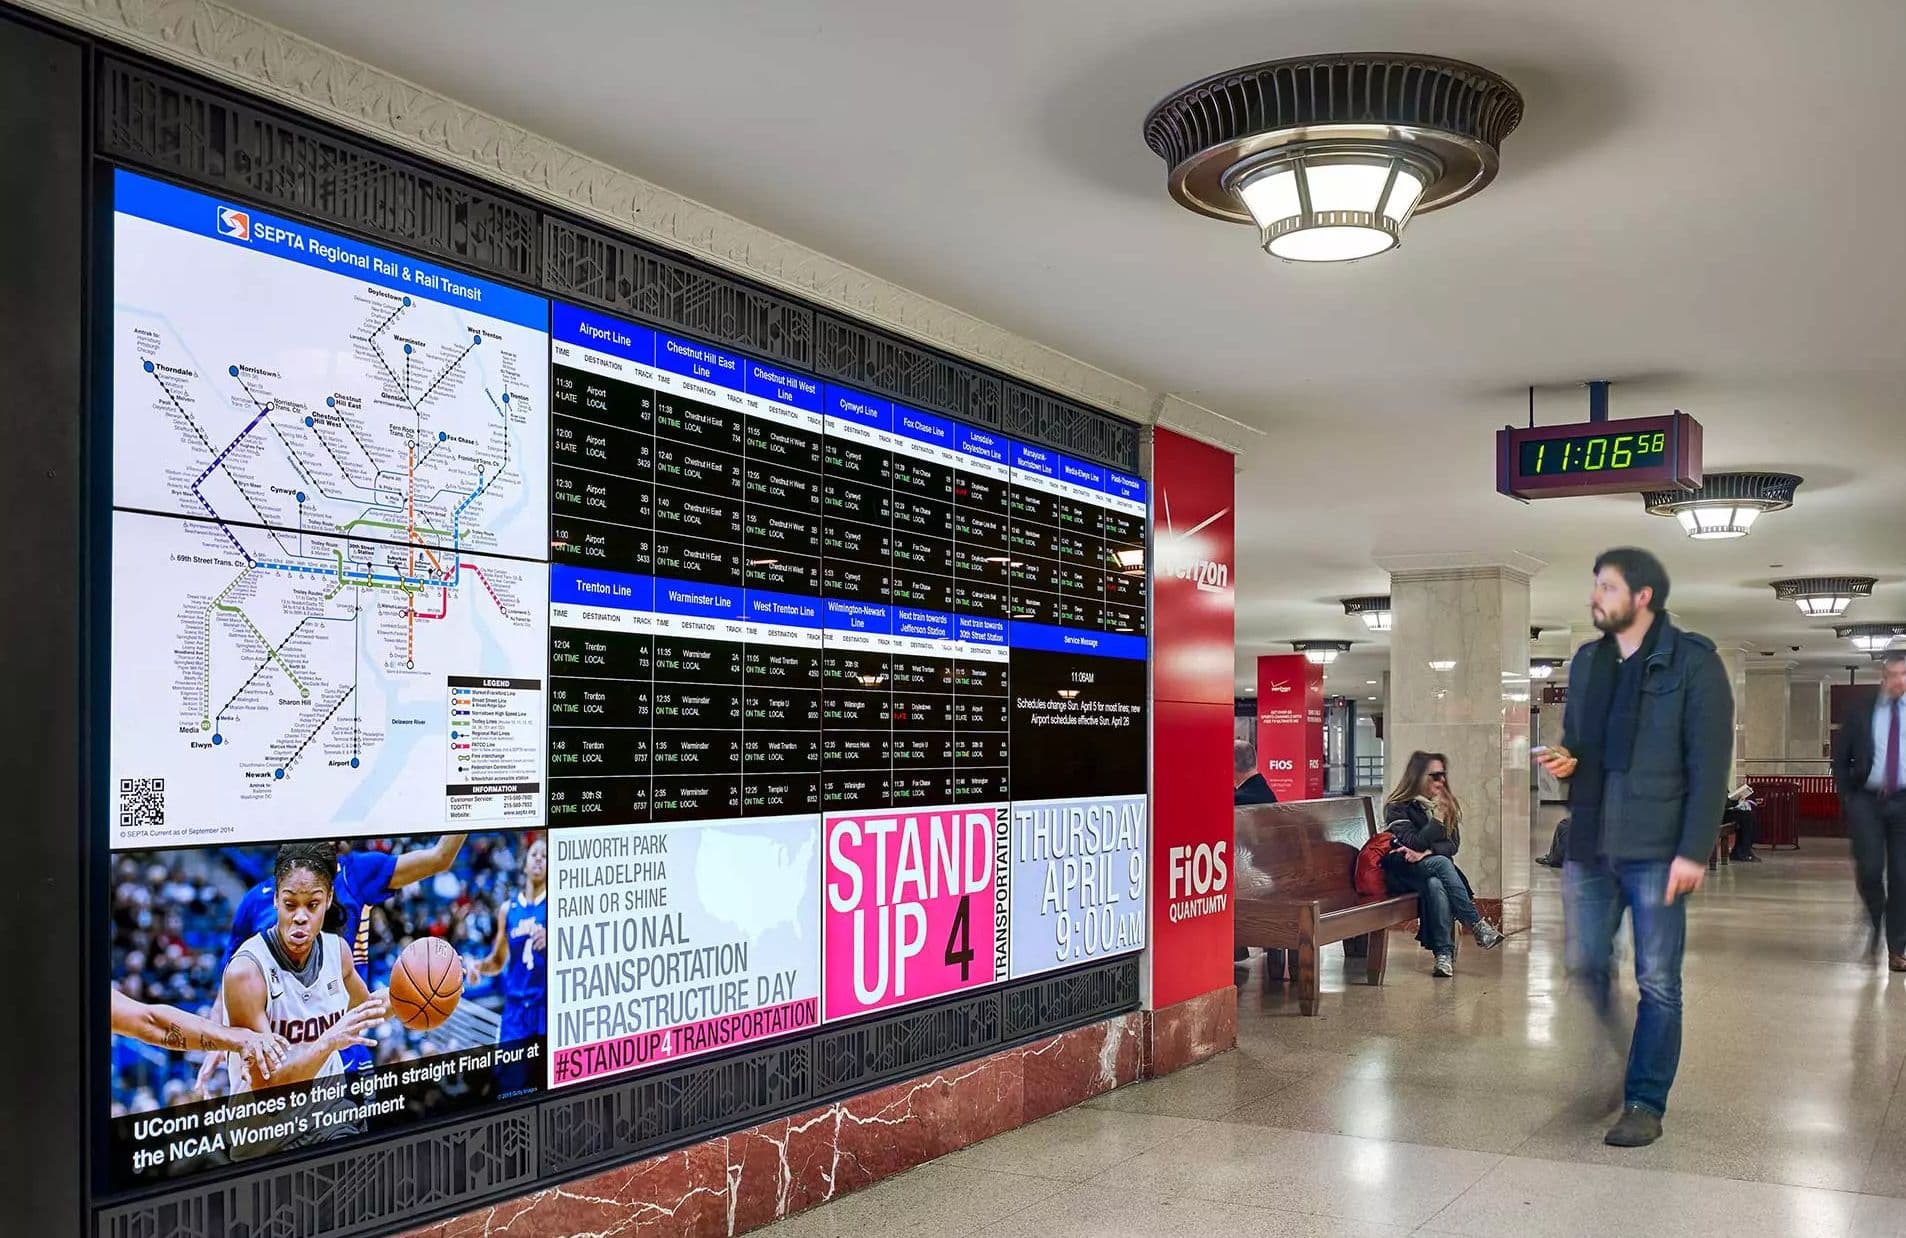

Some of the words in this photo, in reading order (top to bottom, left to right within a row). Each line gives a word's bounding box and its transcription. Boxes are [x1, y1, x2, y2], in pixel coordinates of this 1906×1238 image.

[254, 222, 304, 251] SEPTA
[309, 239, 369, 270] Regional
[373, 257, 398, 279] Rail
[401, 267, 412, 282] &
[415, 270, 439, 290] Rail
[440, 277, 482, 302] Transit
[367, 287, 401, 302] Doylestown
[394, 334, 426, 348] Warminster
[467, 326, 481, 336] West
[481, 329, 503, 341] Trenton
[579, 321, 611, 342] Airport
[612, 331, 632, 347] Line
[555, 346, 570, 357] TIME
[584, 354, 623, 372] DESTINATION
[635, 368, 653, 379] TRACK
[666, 340, 703, 361] Chestnut
[704, 351, 717, 365] Hill
[718, 356, 736, 371] East
[156, 363, 193, 377] Thorndale
[239, 364, 277, 378] Norristown
[693, 363, 711, 378] Line
[556, 378, 573, 389] 11:30
[586, 386, 607, 398] Airport
[753, 367, 786, 386] Chestnut
[786, 377, 798, 389] Hill
[798, 381, 816, 395] West
[334, 393, 361, 404] Chestnut
[561, 393, 578, 403] LATE
[586, 398, 608, 411] LOCAL
[777, 388, 793, 402] Line
[348, 401, 361, 409] East
[839, 398, 864, 415] Cynwyd
[864, 405, 878, 418] Line
[312, 411, 340, 422] Chestnut
[314, 418, 324, 426] Hill
[326, 420, 342, 428] West
[903, 417, 915, 429] Fox
[915, 421, 932, 434] Chase
[932, 425, 945, 438] Line
[456, 436, 475, 446] Chase
[990, 448, 1002, 460] Line
[1535, 436, 1633, 474] 11:06
[1637, 433, 1665, 454] 58
[270, 486, 296, 496] Cynwyd
[176, 554, 192, 563] 69th
[193, 555, 213, 565] Street
[213, 558, 234, 567] Trans.
[234, 560, 246, 568] Ctr.
[576, 579, 611, 594] Trenton
[612, 583, 632, 597] Line
[669, 590, 713, 606] Warminster
[714, 596, 732, 608] Line
[753, 600, 772, 612] West
[773, 603, 799, 615] Trenton
[800, 606, 815, 617] Line
[828, 601, 886, 617] Wilmington-Newark
[553, 609, 568, 618] TIME
[582, 612, 621, 622] DESTINATION
[633, 616, 652, 625] TRACK
[851, 618, 864, 628] Line
[899, 610, 912, 621] Next
[912, 611, 925, 621] train
[926, 614, 948, 624] towards
[960, 618, 972, 627] Next
[972, 619, 984, 628] train
[984, 621, 1004, 631] towards
[901, 623, 927, 634] Jefferson
[927, 626, 946, 636] Station
[987, 632, 1004, 642] Station
[554, 640, 570, 649] 12:04
[585, 642, 607, 652] Trenton
[1064, 635, 1080, 645] Service
[1080, 638, 1098, 648] Message
[553, 653, 564, 662] ON
[564, 654, 580, 662] TIME
[584, 655, 606, 664] LOCAL
[483, 679, 510, 688] LEGEND
[278, 698, 300, 706] Sharon
[1017, 697, 1046, 709] Schedules
[1047, 700, 1067, 712] change
[1067, 700, 1080, 711] Sun.
[1080, 700, 1092, 713] April
[1105, 703, 1117, 712] most
[1131, 705, 1141, 713] new
[1031, 714, 1050, 726] Airport
[1050, 714, 1077, 725] schedules
[1078, 715, 1098, 725] effective
[1111, 716, 1123, 728] April
[179, 726, 200, 734] Media
[190, 741, 213, 750] Elwyn
[328, 760, 350, 768] Airport
[1269, 760, 1293, 770] FiOS
[245, 771, 272, 779] Newark
[472, 784, 518, 794] INFORMATION
[127, 830, 149, 838] SEPTA
[149, 829, 172, 837] Current
[188, 827, 219, 837] September
[1015, 802, 1144, 863] THURSDAY
[557, 837, 629, 862] DILWORTH
[633, 834, 668, 856] PARK
[828, 812, 994, 913] STAND
[1169, 841, 1227, 899] FiOS
[558, 860, 667, 890] PHILADELPHIA
[1041, 853, 1120, 916] APRIL
[1128, 851, 1143, 900] 9
[995, 807, 1009, 982] TRANSPORTATION
[557, 895, 594, 918] RAIN
[599, 892, 620, 914] OR
[625, 887, 667, 911] SHINE
[557, 912, 690, 962] NATIONAL
[1056, 905, 1143, 962] 9:00AM
[853, 901, 927, 1005] UP
[944, 895, 975, 982] 4
[556, 941, 748, 1004] TRANSPORTATION
[557, 979, 750, 1048] INFRASTRUCTURE
[757, 969, 797, 1006] DAY
[556, 999, 817, 1081] #STANDUP4TRANSPORTATION
[134, 1114, 199, 1141] UConn
[204, 1096, 286, 1126] advances
[290, 1091, 307, 1107] to
[311, 1082, 348, 1104] their
[350, 1072, 398, 1097] eighth
[402, 1062, 456, 1085] straight
[459, 1054, 491, 1072] Final
[495, 1048, 525, 1066] Four
[527, 1042, 539, 1058] at
[133, 1149, 165, 1169] the
[169, 1133, 225, 1161] NCAA
[229, 1117, 308, 1147] Women's
[312, 1094, 405, 1128] Tournament
